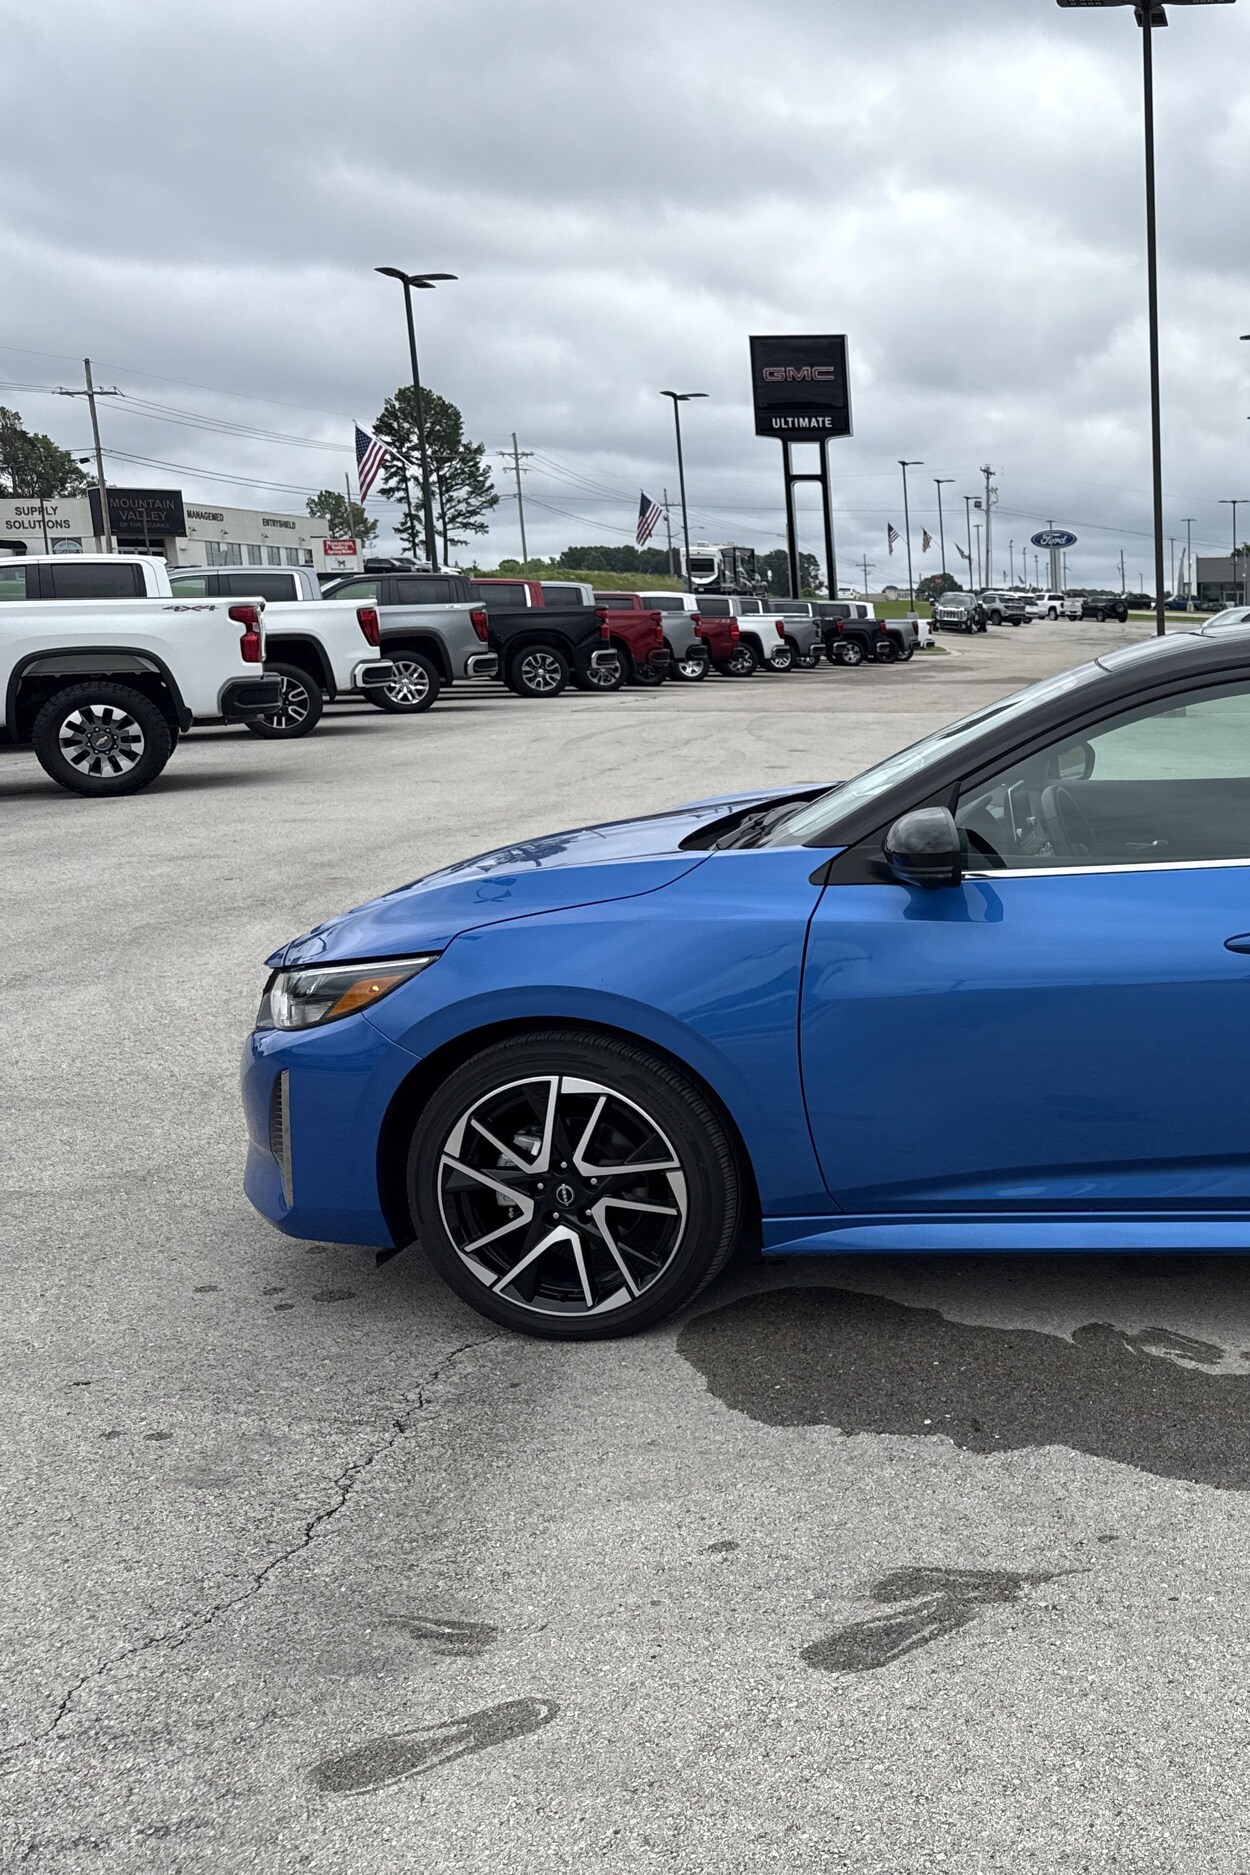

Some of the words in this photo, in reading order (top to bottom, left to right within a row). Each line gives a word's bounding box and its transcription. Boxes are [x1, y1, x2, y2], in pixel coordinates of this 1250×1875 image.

[763, 366, 835, 382] GMC
[772, 417, 833, 429] ULTIMATE
[110, 498, 175, 510] MOUNTAIN
[119, 510, 167, 521] VALLEY
[5, 519, 71, 529] SOLUTONS
[1040, 533, 1067, 545] Ford
